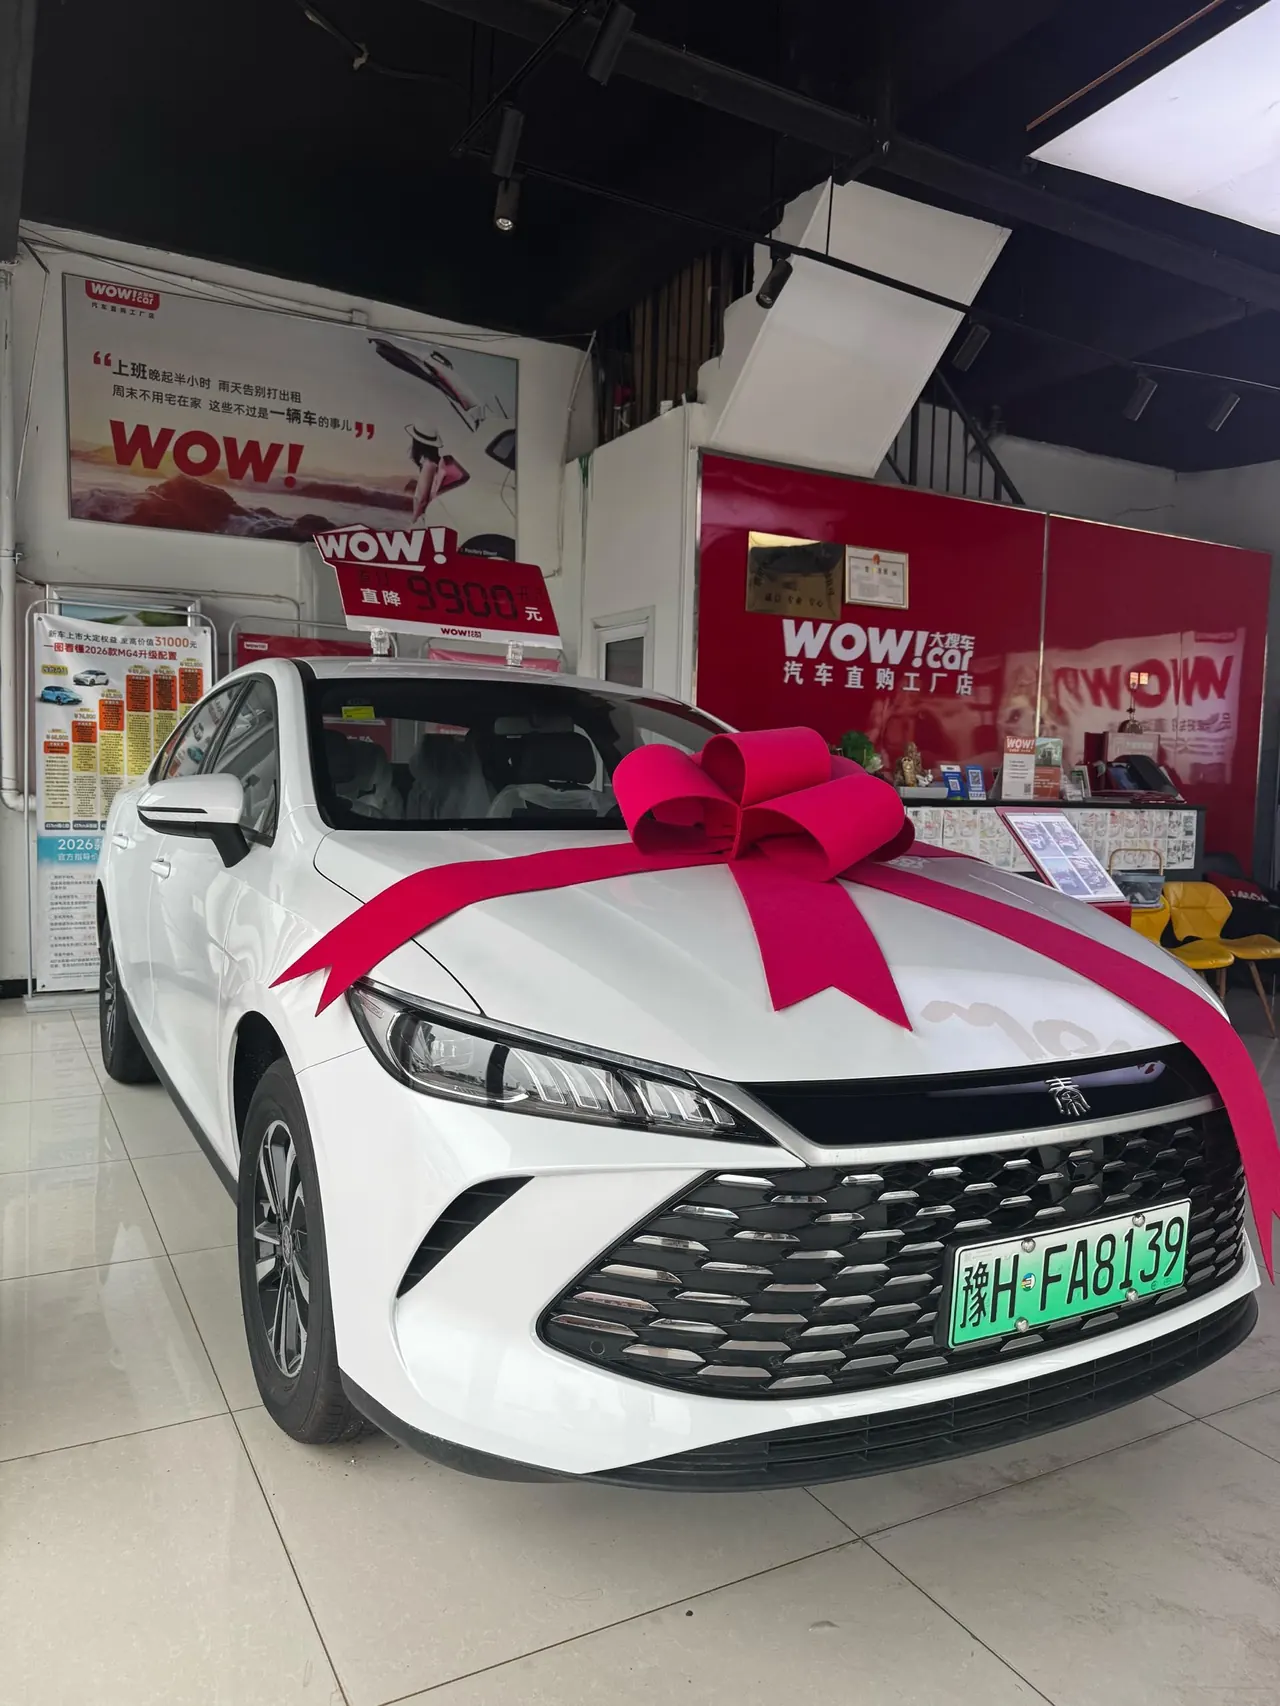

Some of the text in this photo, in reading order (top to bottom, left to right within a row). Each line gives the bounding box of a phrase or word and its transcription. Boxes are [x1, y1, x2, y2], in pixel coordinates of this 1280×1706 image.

[91, 282, 137, 301] WOW!
[112, 385, 202, 409] 周末不用宅在家
[218, 380, 301, 404] 雨天告别打出租
[109, 419, 304, 489] WOW!
[316, 527, 447, 565] WOW!
[359, 587, 402, 608] 直降
[407, 575, 519, 621] 9900
[525, 605, 543, 621] 元
[441, 627, 470, 638] WOW!
[782, 618, 929, 669] WOW!
[929, 632, 975, 650] 大搜车
[926, 647, 974, 672] car
[783, 660, 974, 696] 汽车直购工厂店
[1006, 737, 1035, 750] WOW!
